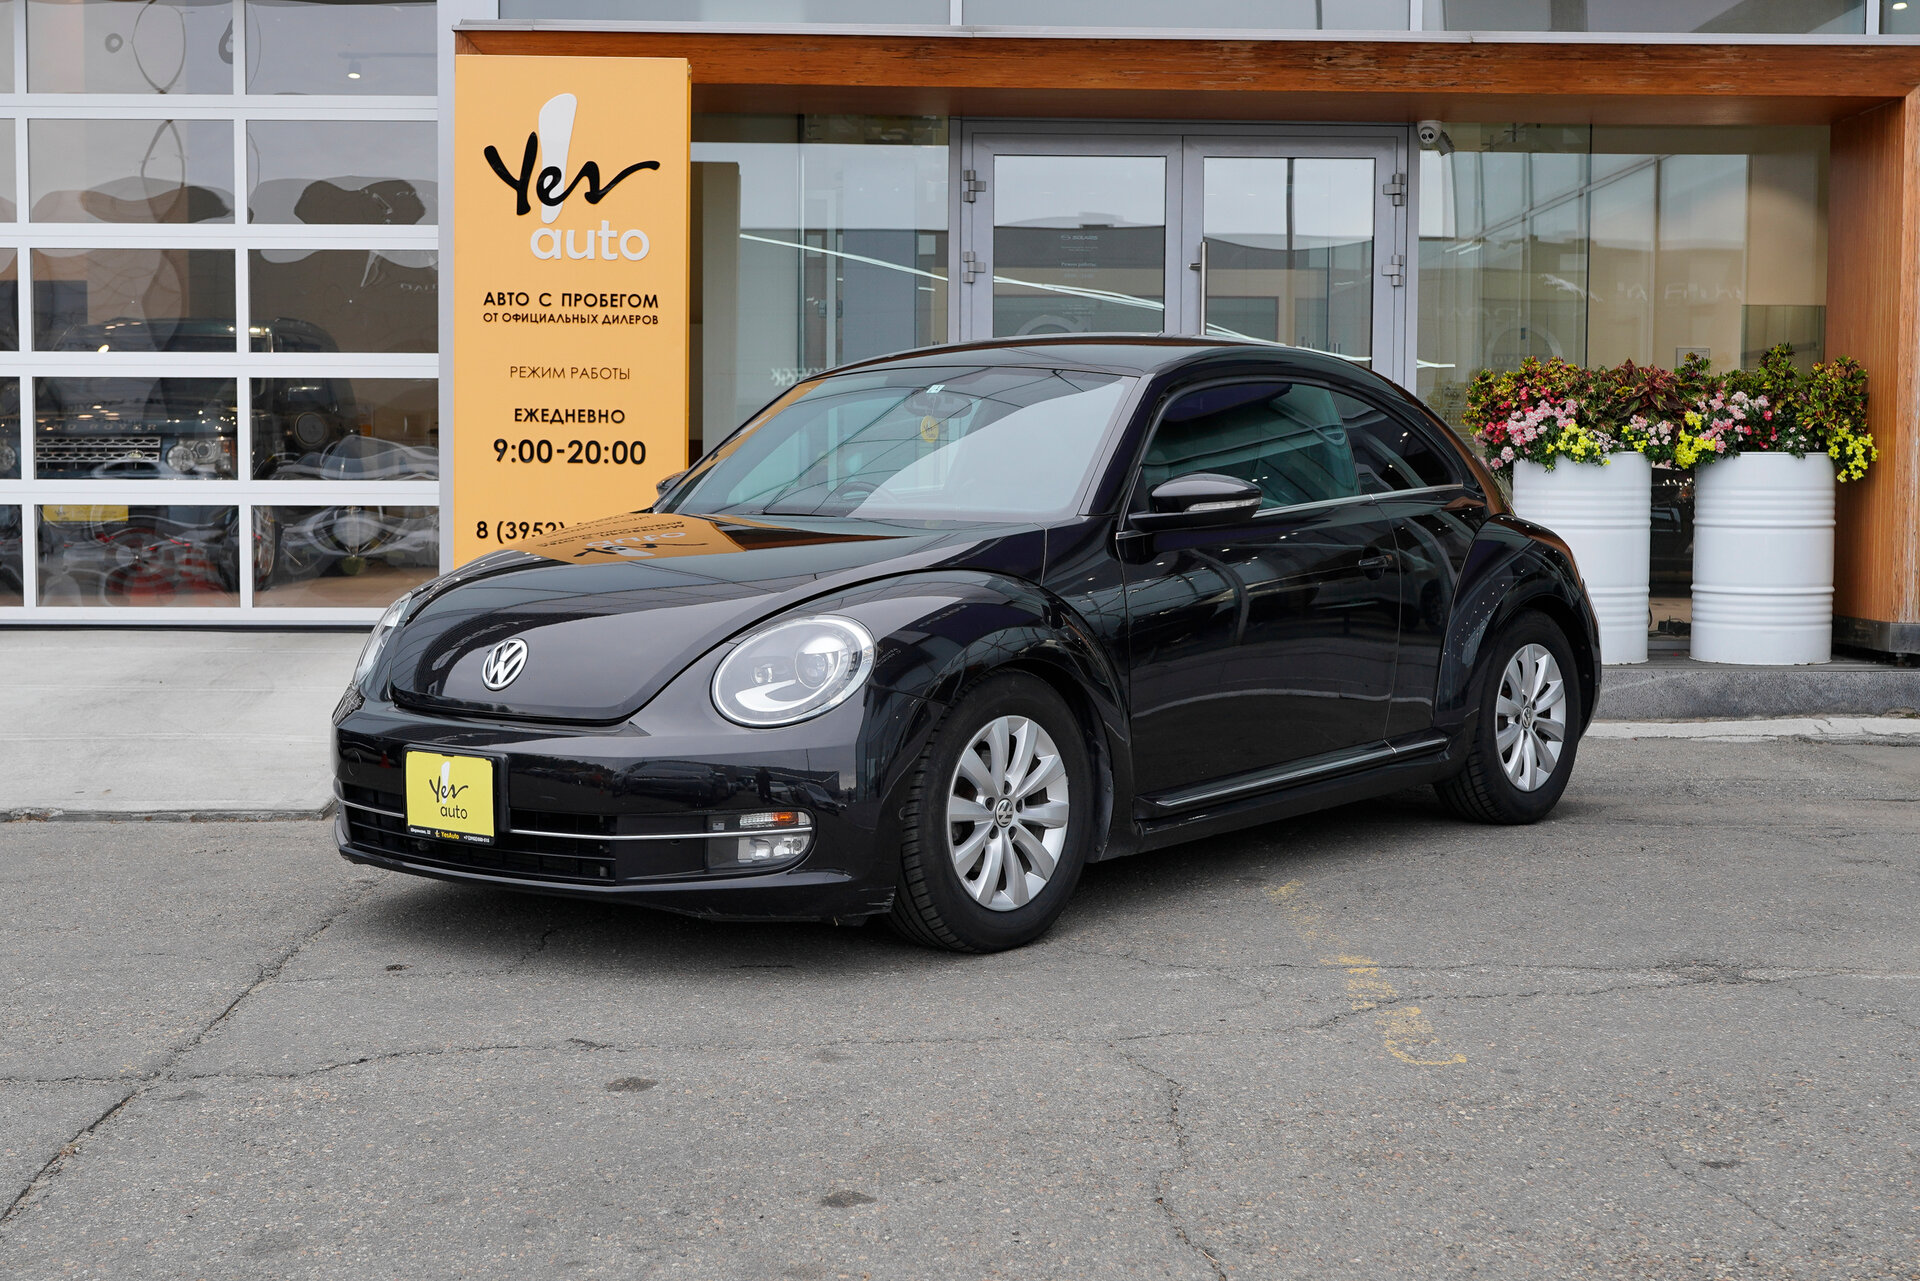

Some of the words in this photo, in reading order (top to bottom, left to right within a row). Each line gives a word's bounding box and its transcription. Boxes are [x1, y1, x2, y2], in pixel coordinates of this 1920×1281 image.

[530, 220, 650, 261] auto
[483, 292, 530, 307] АВТО
[538, 292, 552, 307] С
[561, 293, 659, 309] ПРОБЕГОМ
[483, 312, 499, 323] ОТ
[502, 312, 599, 325] ОФИЦИАЛЬНЫХ
[601, 314, 659, 325] ДИЛЕРОВ
[510, 366, 566, 379] РЕЖИМ
[570, 367, 631, 380] РАБОТЫ
[514, 408, 626, 425] ЕЖЕДНЕВНО
[493, 438, 647, 465] 9:00-20:00
[476, 520, 489, 539] 8
[440, 805, 468, 820] auto
